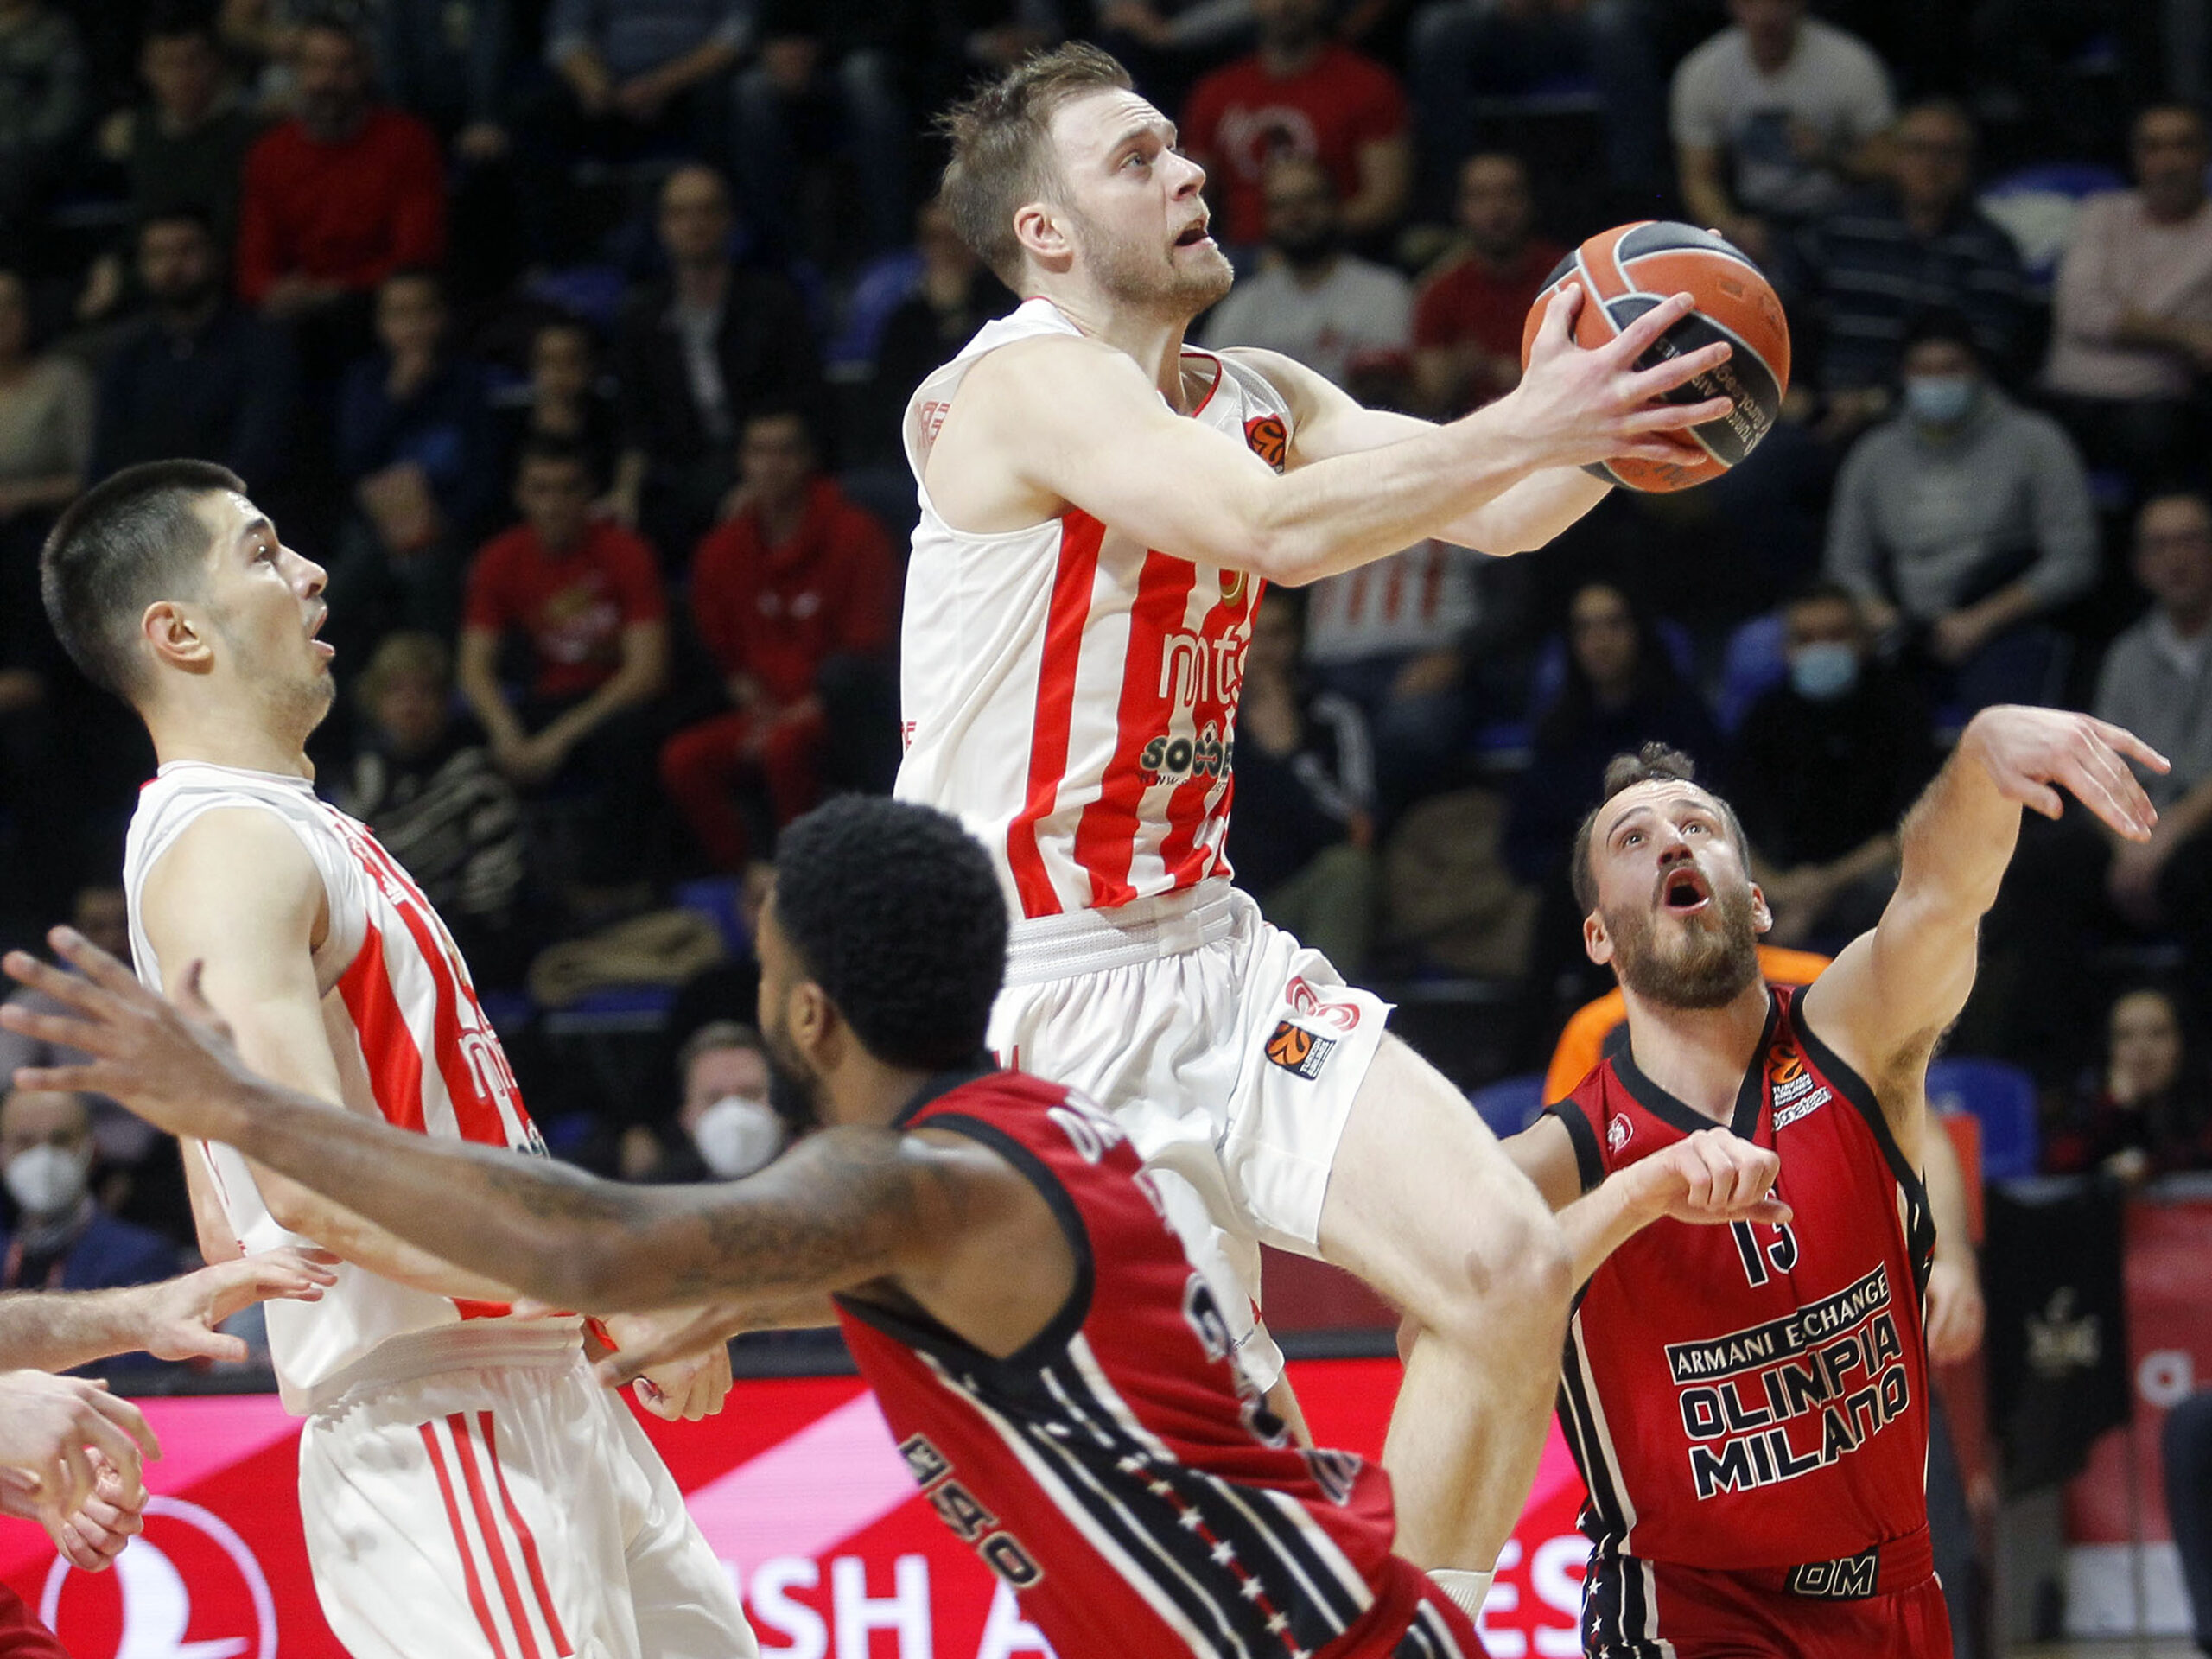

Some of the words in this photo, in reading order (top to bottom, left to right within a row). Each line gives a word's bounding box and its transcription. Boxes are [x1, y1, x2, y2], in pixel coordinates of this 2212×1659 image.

[1677, 1332, 1775, 1376] ARMANI
[1785, 1273, 1889, 1349] ECHANGE
[1794, 1555, 1877, 1596] OM
